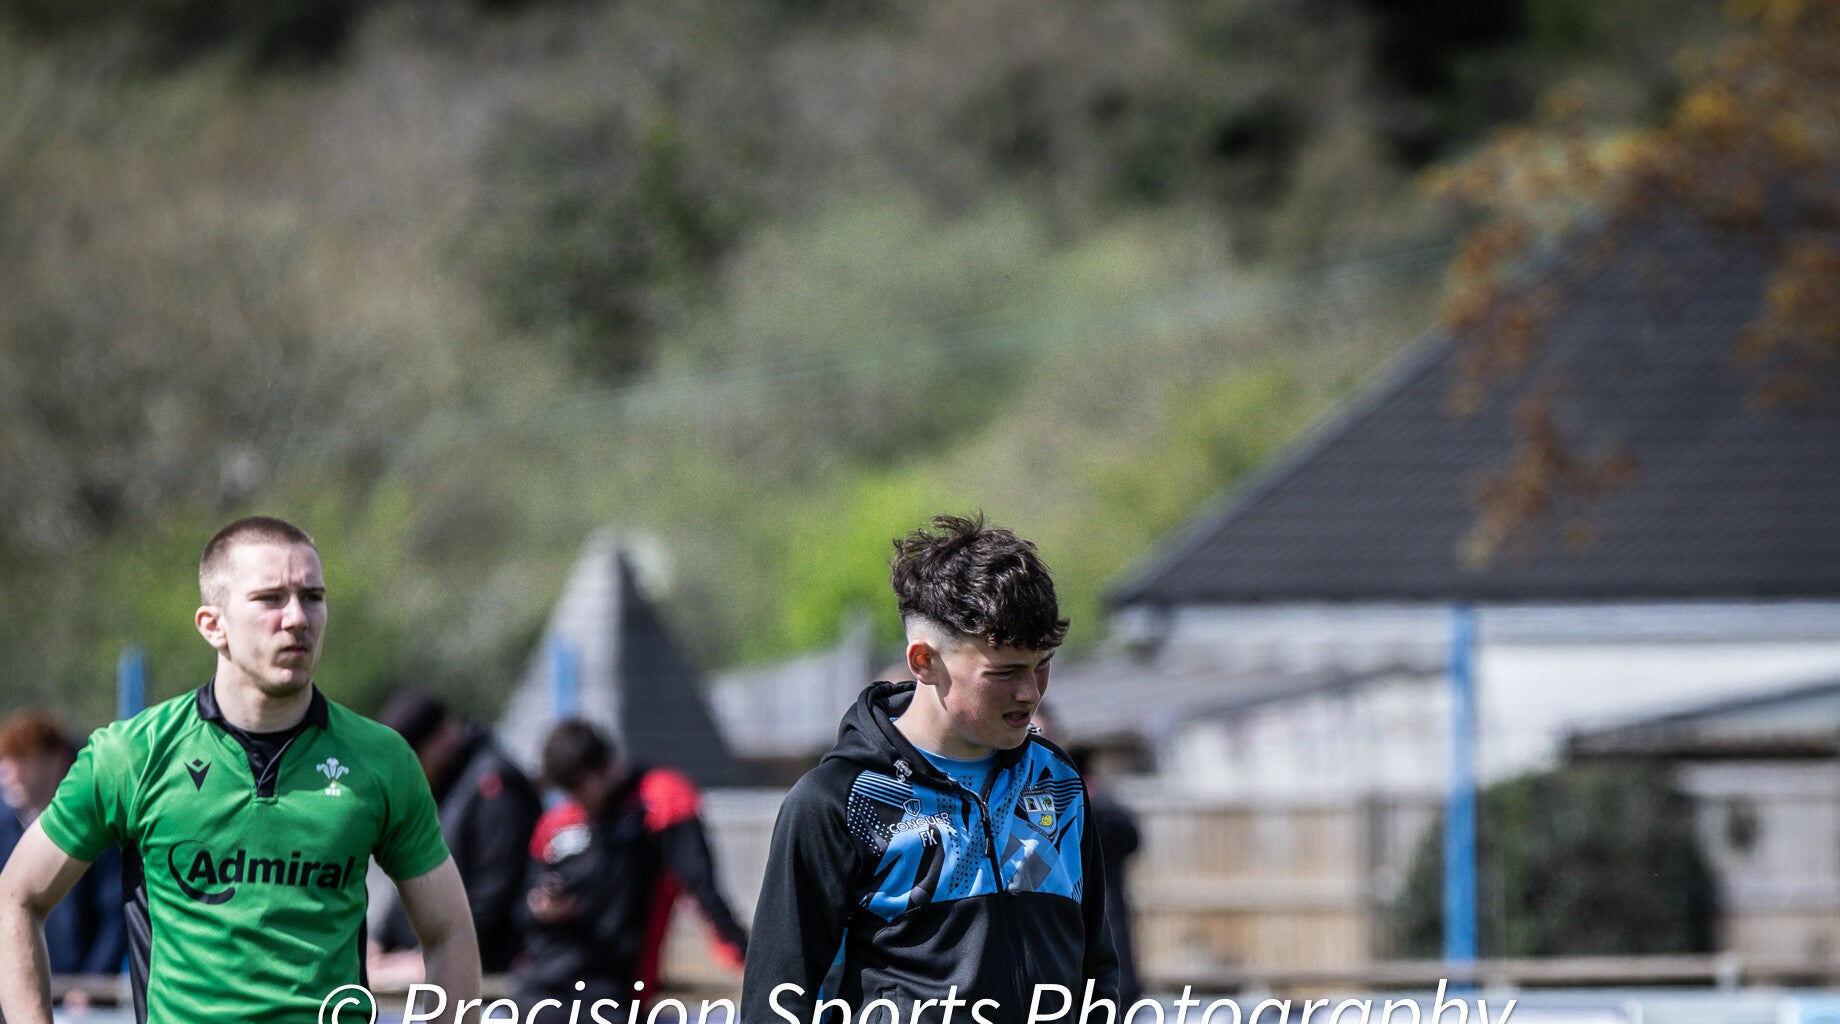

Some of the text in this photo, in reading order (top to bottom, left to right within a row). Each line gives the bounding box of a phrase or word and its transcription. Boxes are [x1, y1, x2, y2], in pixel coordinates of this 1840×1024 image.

[890, 812, 951, 834] CONQUER
[920, 829, 938, 847] FK
[186, 849, 355, 890] Admiral
